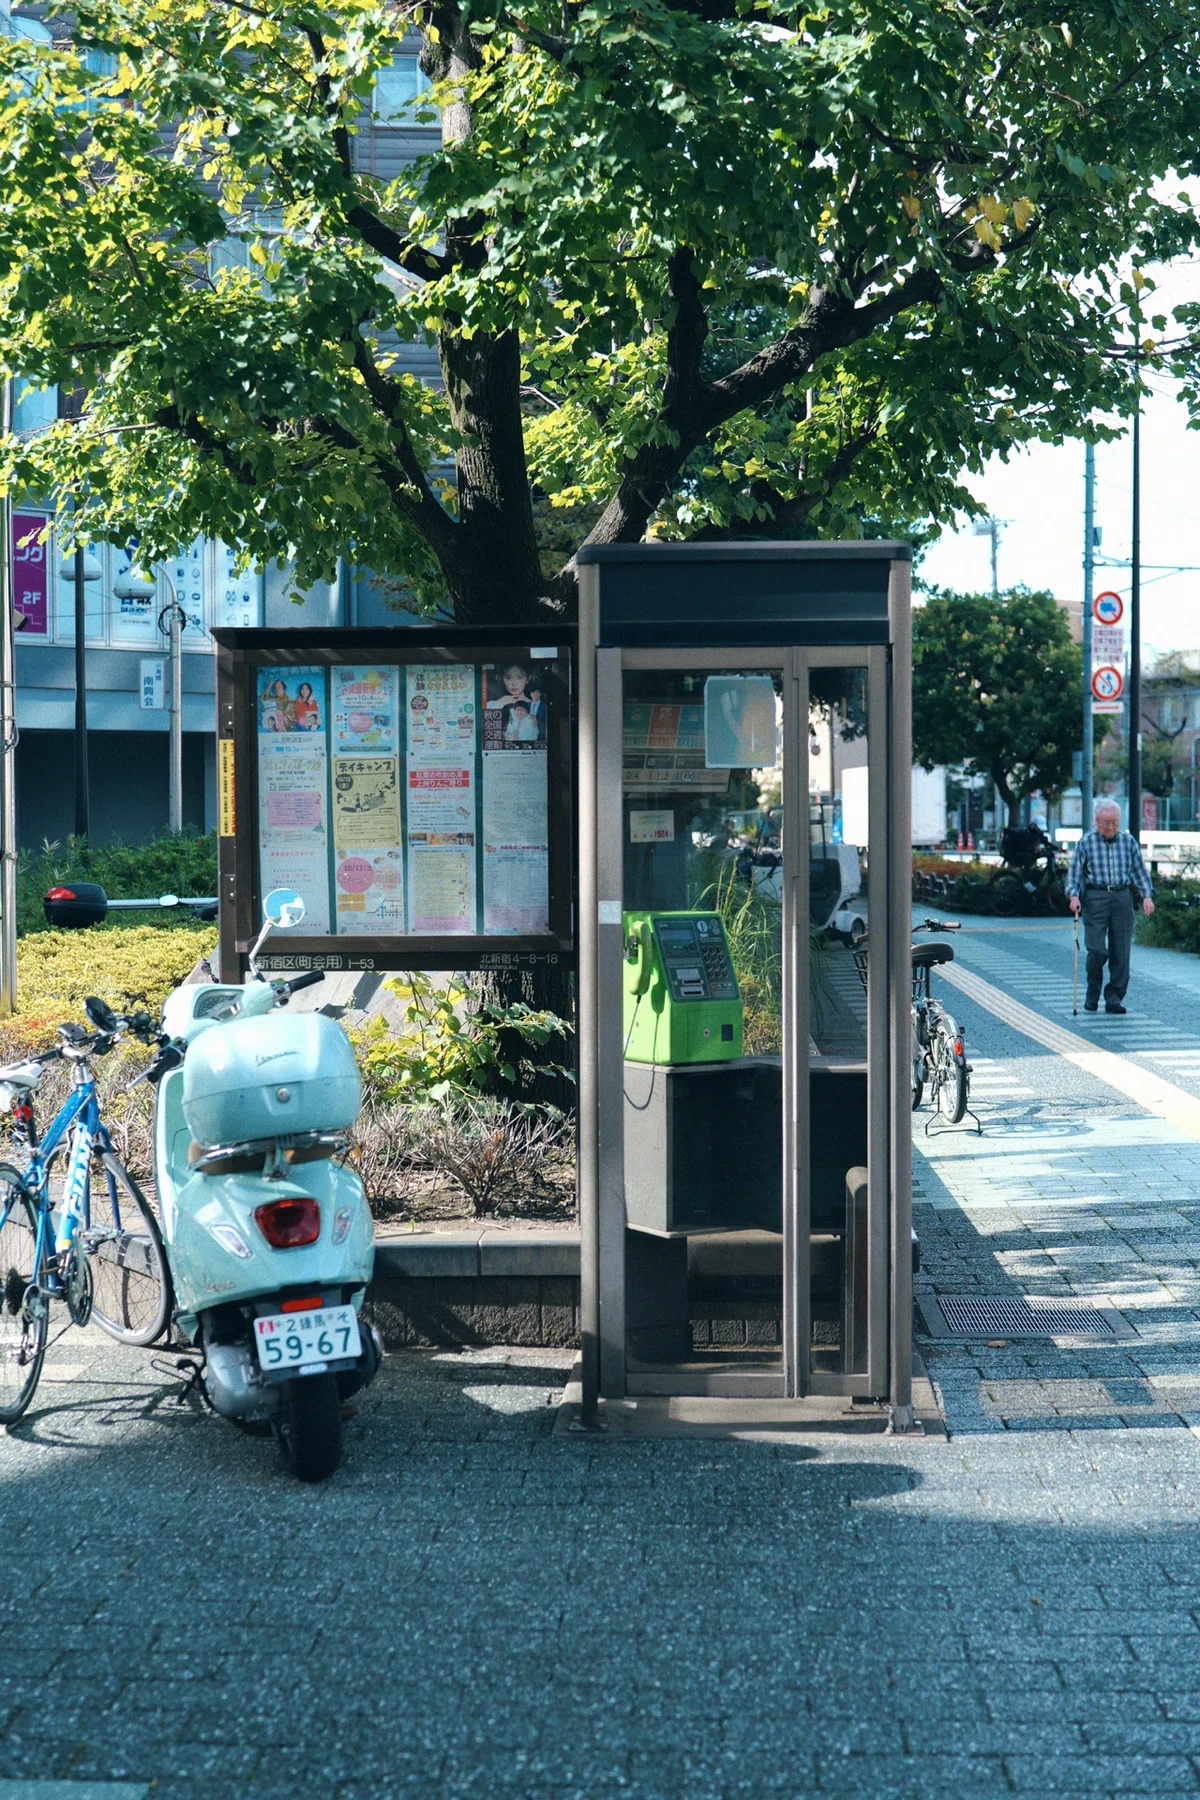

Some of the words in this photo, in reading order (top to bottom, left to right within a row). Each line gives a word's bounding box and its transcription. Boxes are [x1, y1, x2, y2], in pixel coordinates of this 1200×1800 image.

[23, 591, 41, 604] 2F
[484, 710, 502, 720] 秋の
[484, 720, 502, 730] 全国
[264, 1326, 351, 1364] 59-67
